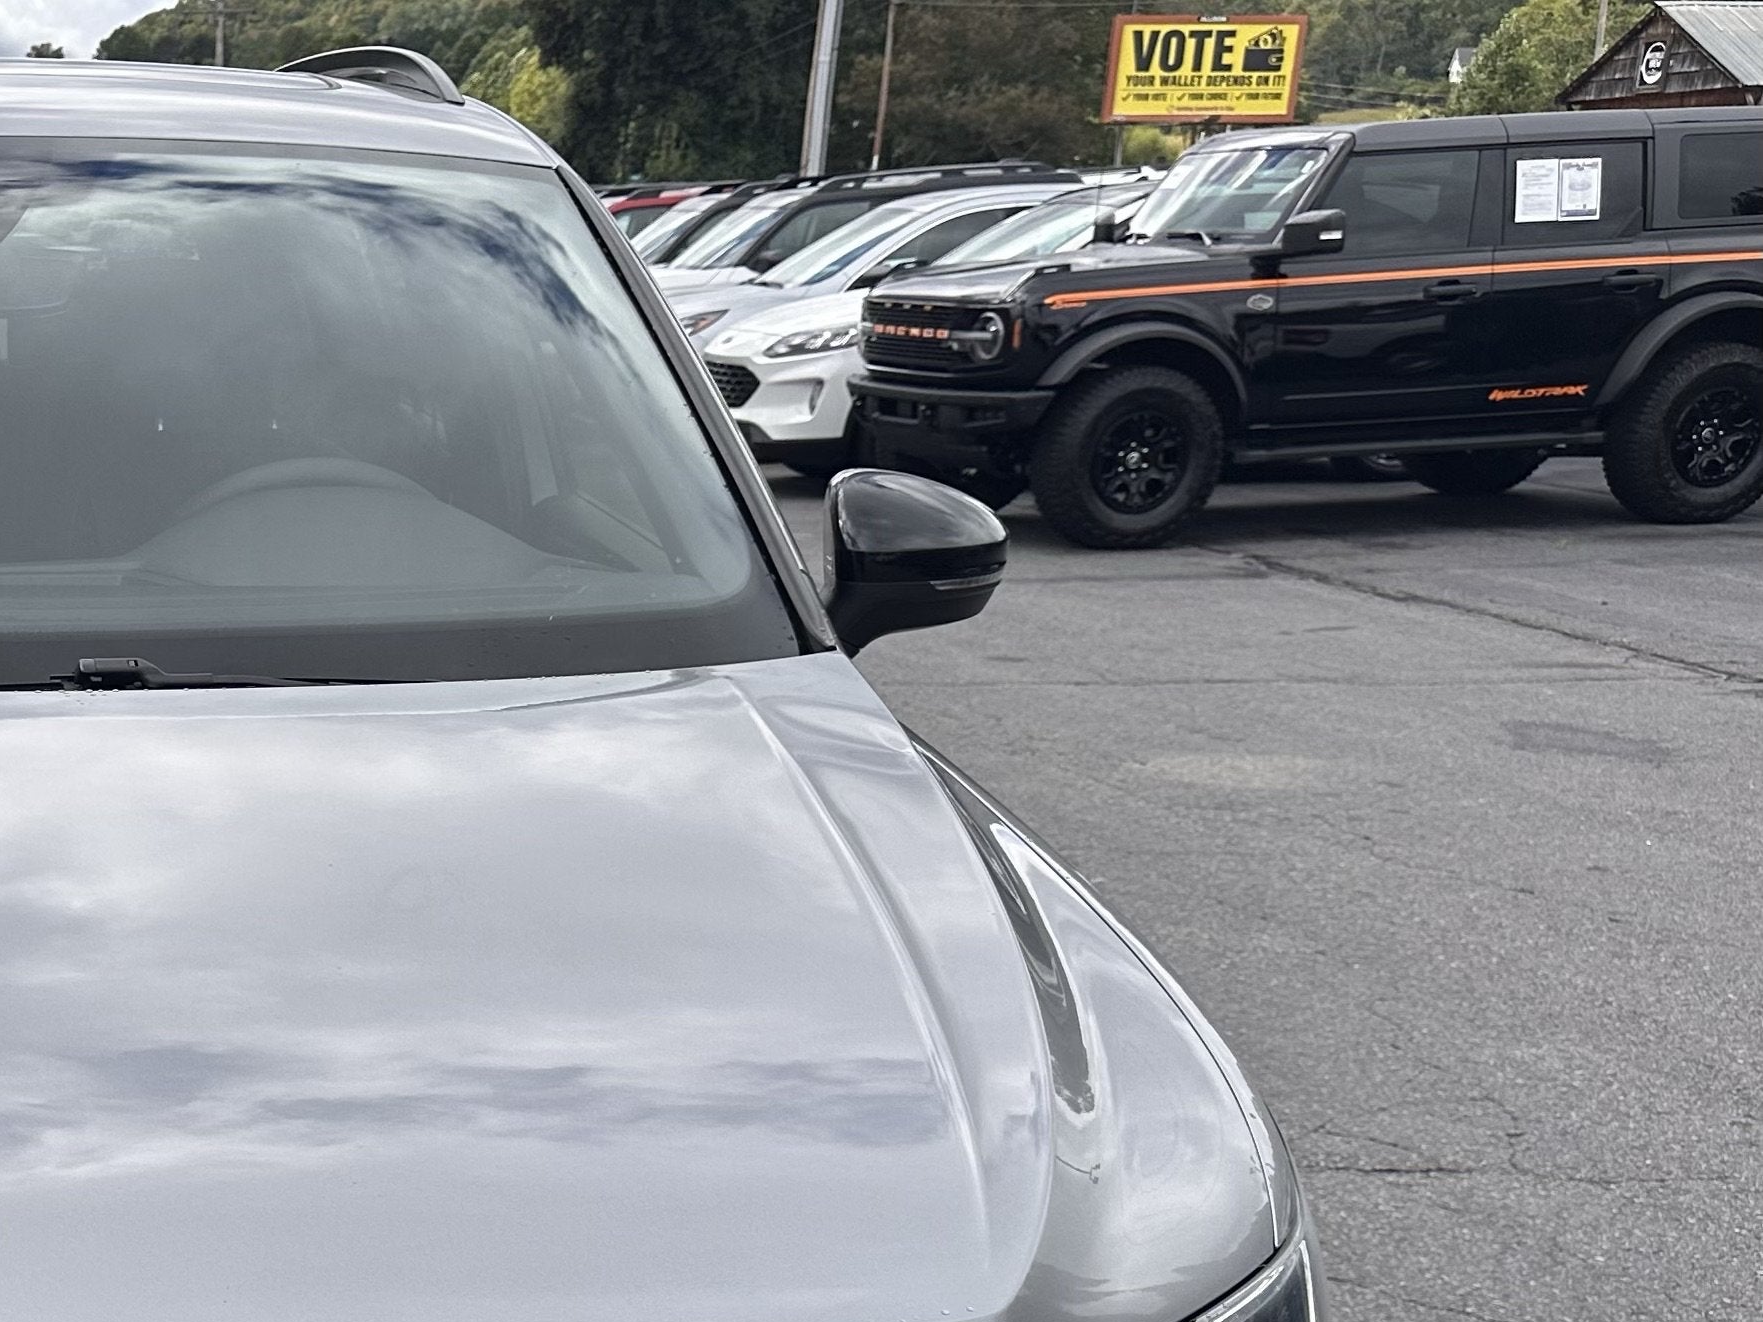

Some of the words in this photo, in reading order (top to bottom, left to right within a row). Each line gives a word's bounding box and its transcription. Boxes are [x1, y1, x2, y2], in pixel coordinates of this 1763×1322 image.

[1132, 29, 1237, 73] VOTE
[1126, 75, 1155, 87] YOUR
[1159, 75, 1203, 87] WALLET
[1206, 75, 1252, 87] DEPENDS
[1255, 75, 1270, 87] ON
[873, 323, 950, 339] BRONCO
